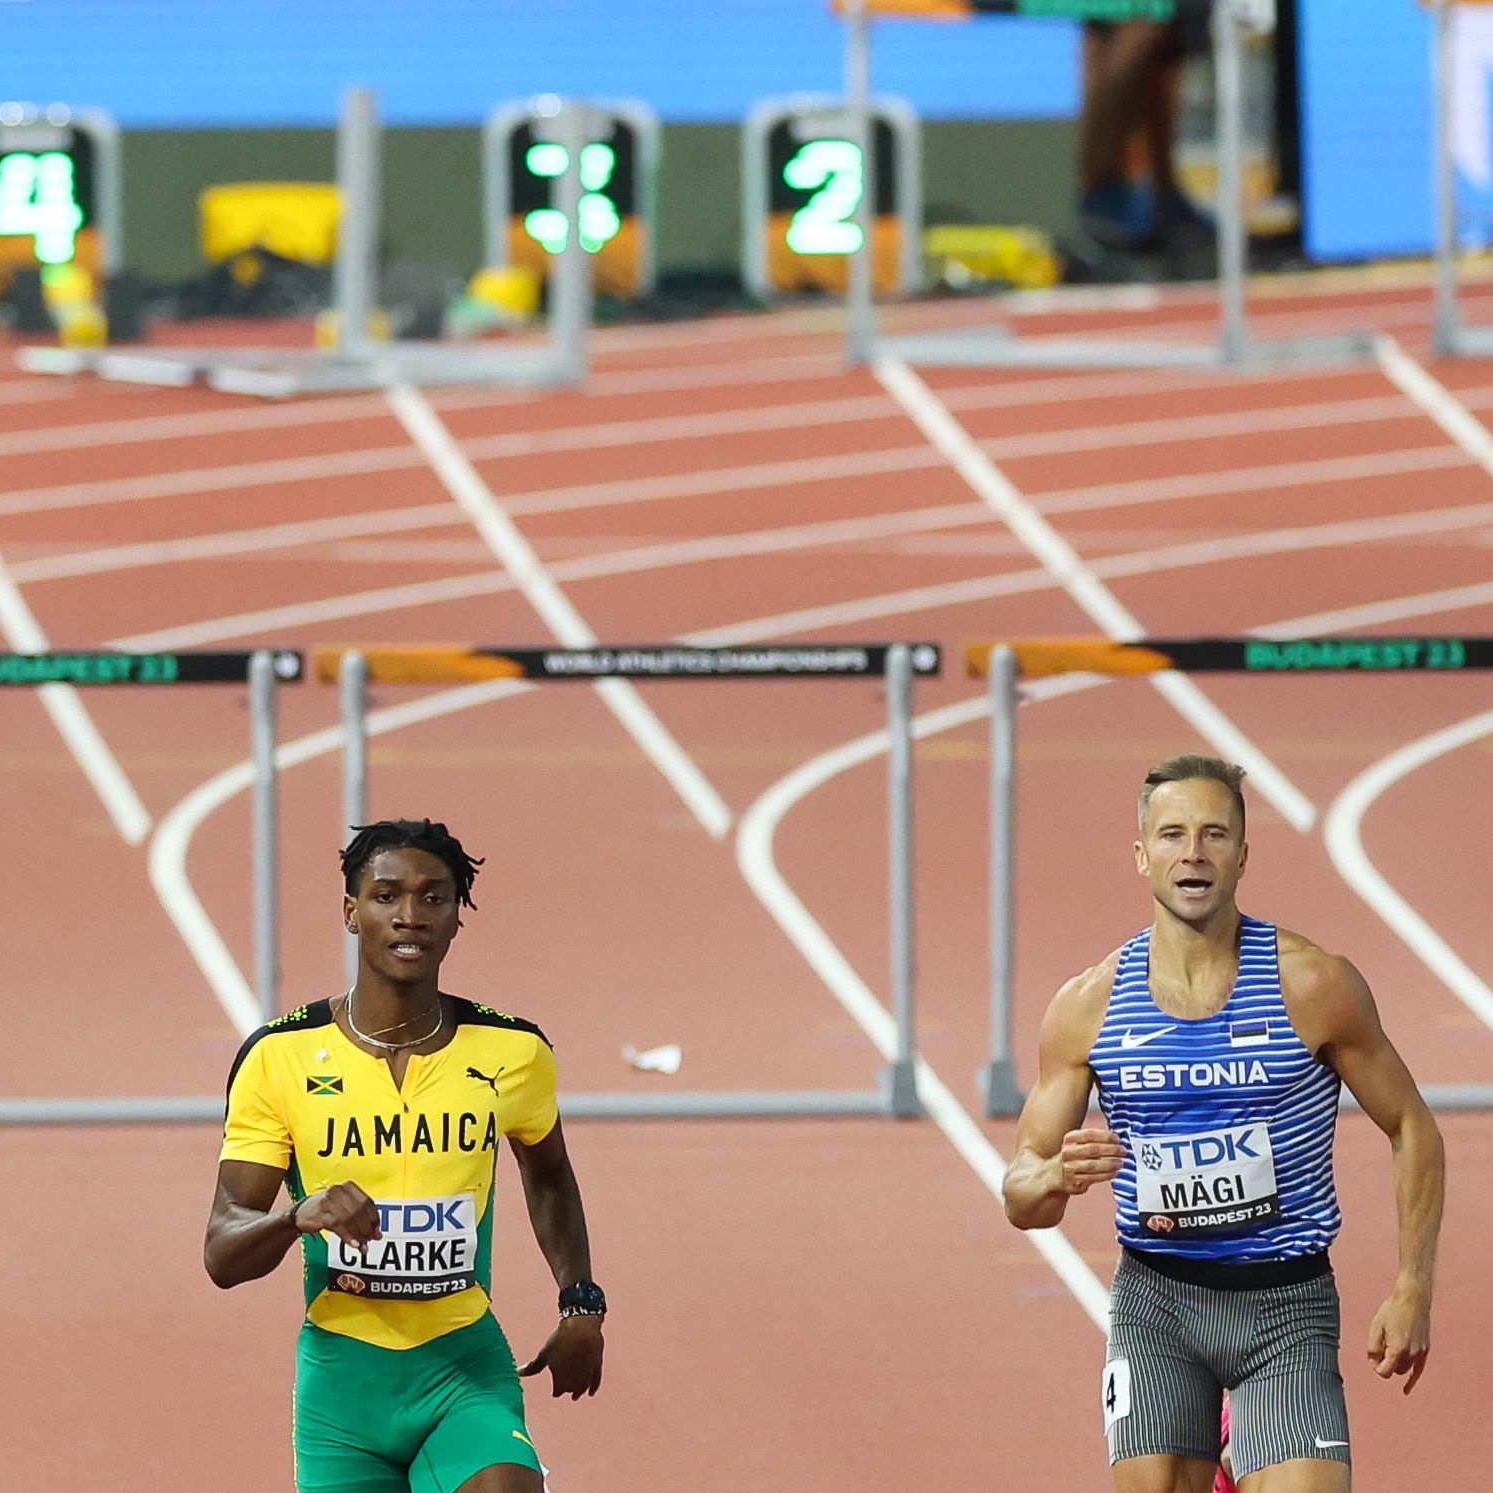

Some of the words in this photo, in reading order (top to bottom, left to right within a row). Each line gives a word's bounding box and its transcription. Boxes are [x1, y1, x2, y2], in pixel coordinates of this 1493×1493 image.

[785, 138, 863, 254] 2
[1119, 1060, 1269, 1090] ESTONIA
[317, 1111, 496, 1157] JAMAICA
[1159, 1129, 1260, 1169] TDK
[1159, 1174, 1246, 1210] MÄGI
[375, 1200, 465, 1233] TDK
[1177, 1208, 1254, 1228] BUDAPEST
[1255, 1203, 1272, 1217] 23
[339, 1238, 467, 1271] CLARKE
[370, 1281, 449, 1294] BUDAPEST
[451, 1279, 467, 1291] 23
[1106, 1372, 1116, 1413] 4
